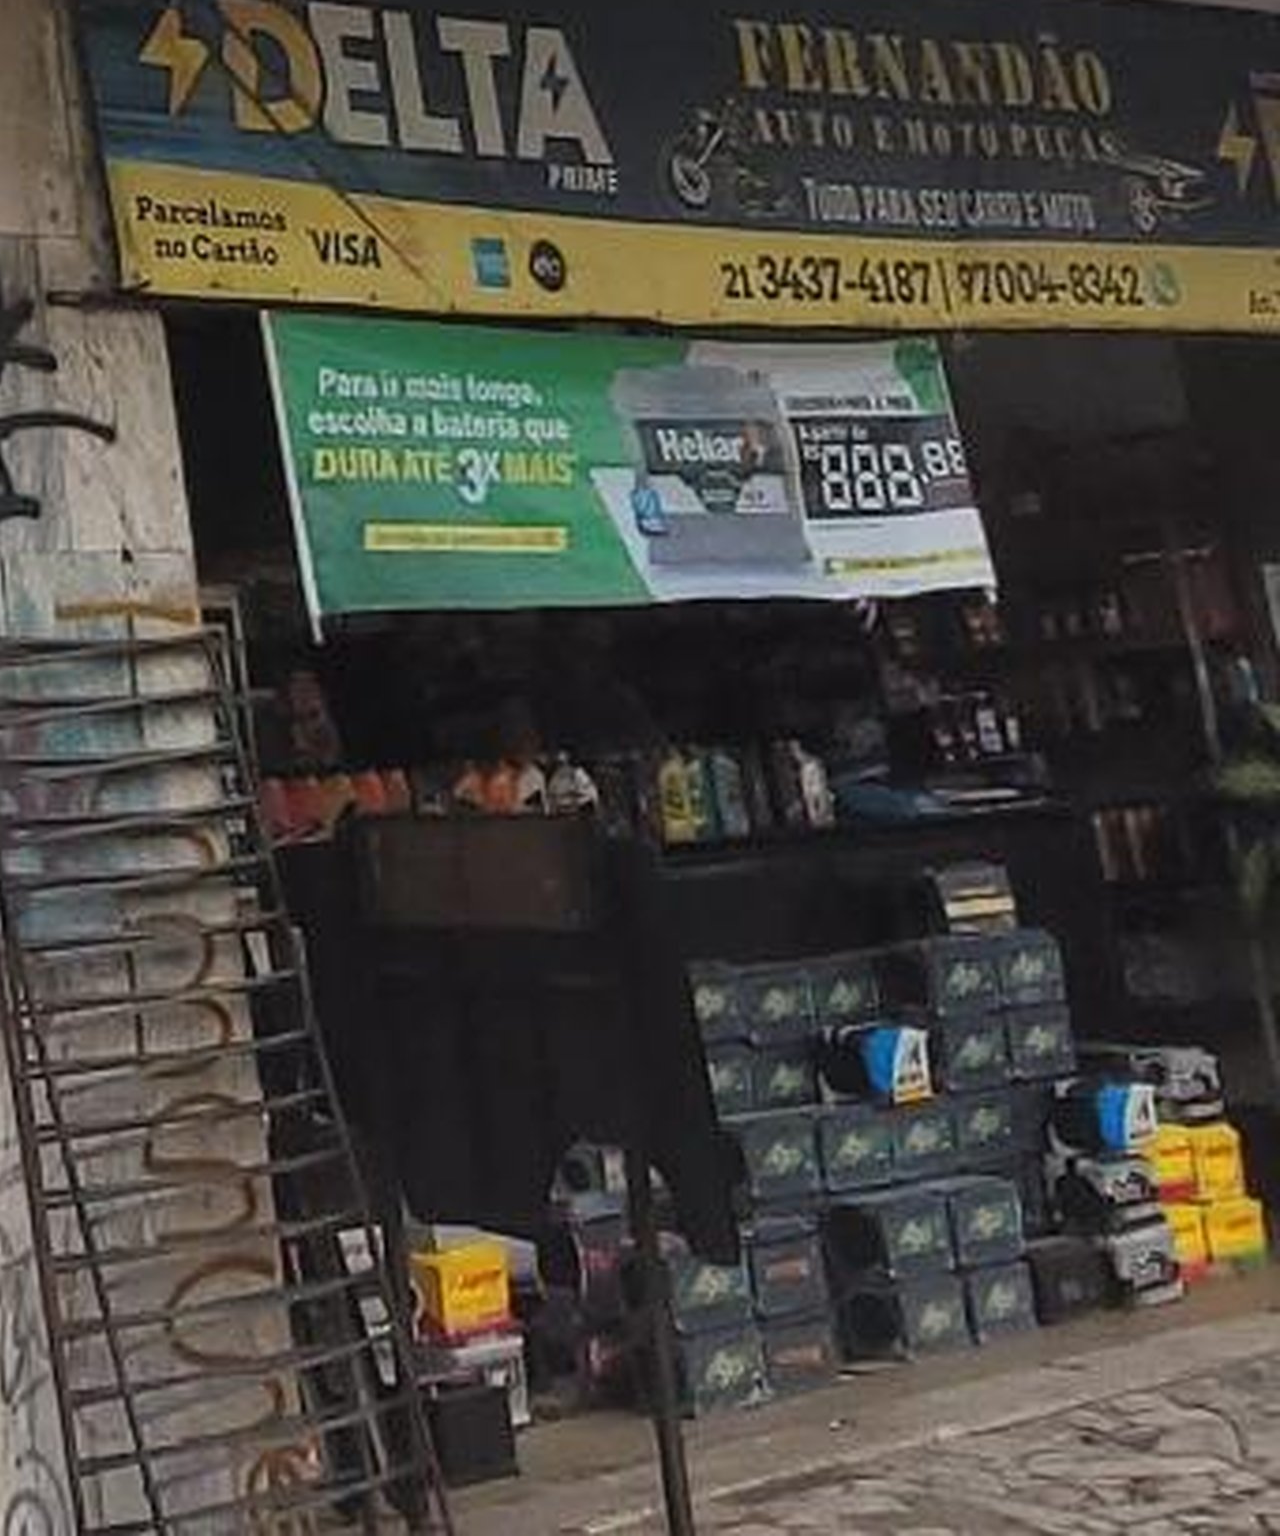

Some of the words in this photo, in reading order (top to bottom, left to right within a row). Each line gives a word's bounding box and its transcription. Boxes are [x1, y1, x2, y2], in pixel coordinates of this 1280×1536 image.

[733, 18, 1113, 115] FERNANDÃO
[751, 108, 855, 148] AUTO
[547, 165, 619, 195] PRIME
[136, 196, 288, 233] Parcelamos
[862, 184, 919, 225] PARA
[919, 187, 958, 227] SEU
[154, 238, 186, 261] no
[191, 234, 280, 267] Cartão
[308, 228, 382, 270] VISA
[757, 255, 931, 304] 3437-4187
[955, 260, 1144, 306] 97004-8342
[318, 367, 379, 398] Para
[404, 372, 463, 402] mais
[308, 407, 407, 437] escolha
[412, 415, 428, 436] a
[431, 408, 522, 441] bateria
[524, 418, 571, 447] que
[313, 448, 400, 481] DURA
[502, 450, 577, 484] MAIS
